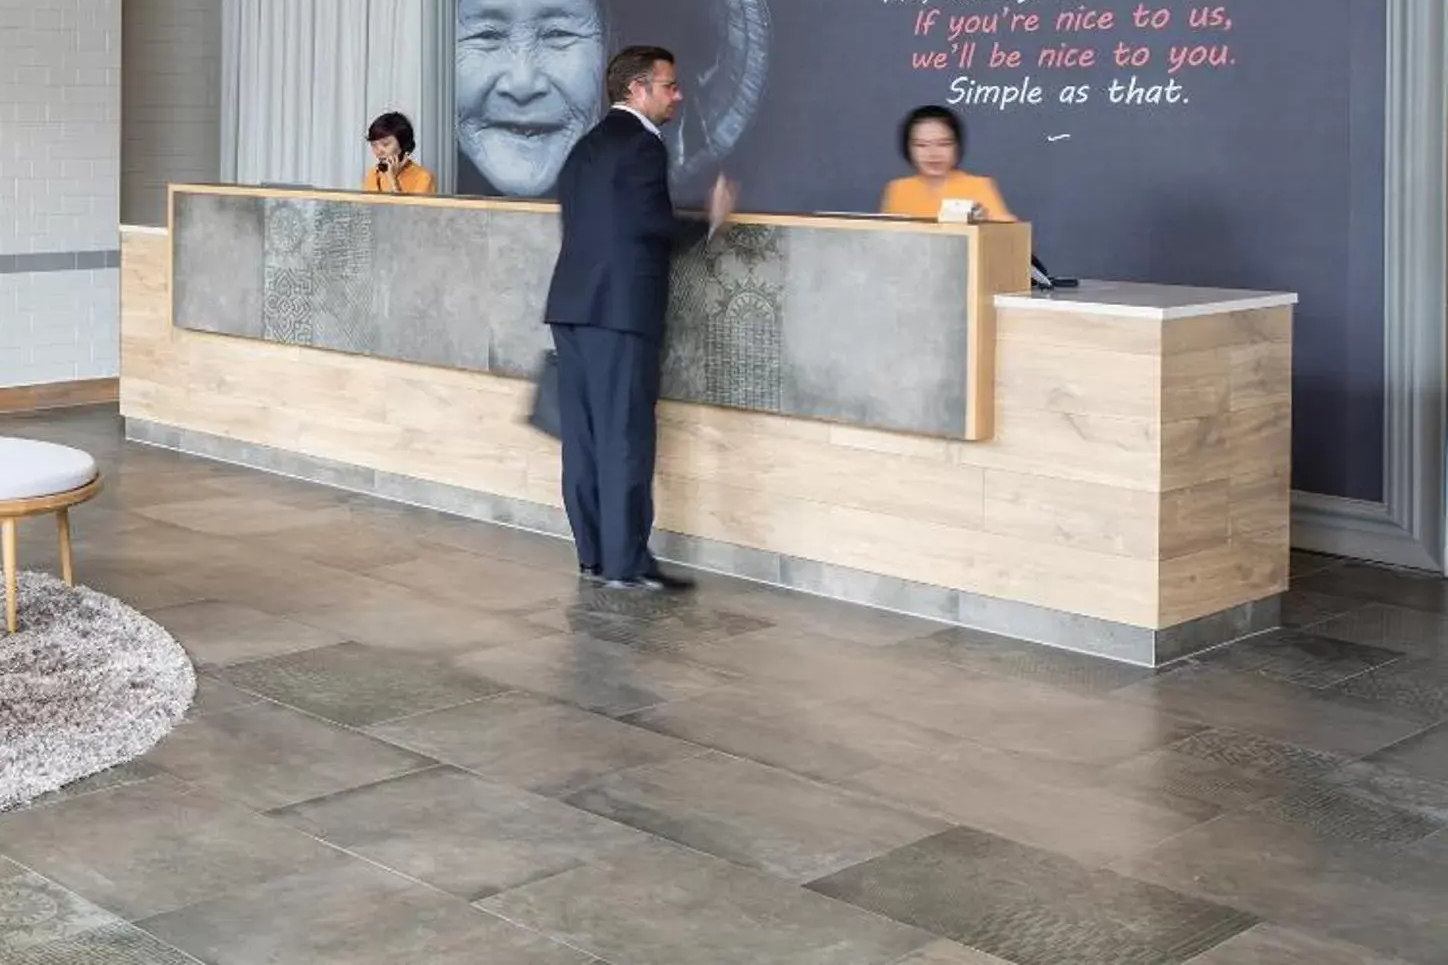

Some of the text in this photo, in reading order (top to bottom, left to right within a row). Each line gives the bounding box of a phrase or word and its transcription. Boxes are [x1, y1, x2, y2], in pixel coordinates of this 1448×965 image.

[915, 9, 940, 36] If
[1056, 5, 1114, 31] nice
[1133, 3, 1171, 29] to
[1189, 6, 1232, 31] us,
[990, 42, 1021, 68] be
[1038, 43, 1095, 68] nice
[1114, 42, 1150, 67] to
[1168, 45, 1236, 74] you.
[946, 75, 1190, 110] Simple as that.
